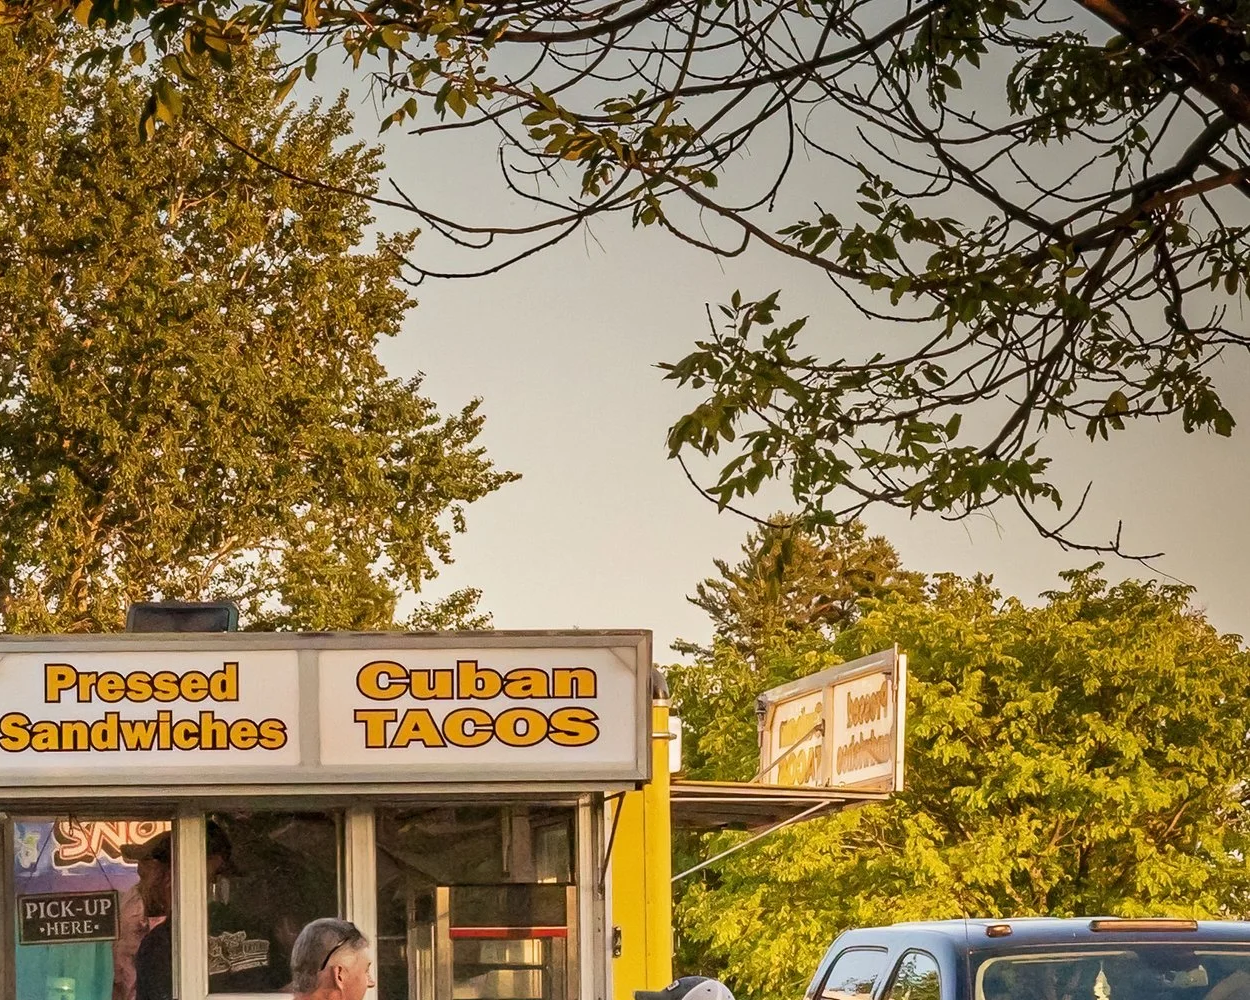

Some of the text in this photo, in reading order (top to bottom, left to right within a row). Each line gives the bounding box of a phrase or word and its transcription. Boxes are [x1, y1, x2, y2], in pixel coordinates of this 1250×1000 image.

[44, 661, 240, 704] Pressed
[356, 660, 598, 699] Cuban
[355, 707, 600, 749] TACOS
[57, 820, 172, 861] SNO
[25, 899, 112, 919] PICK-UP
